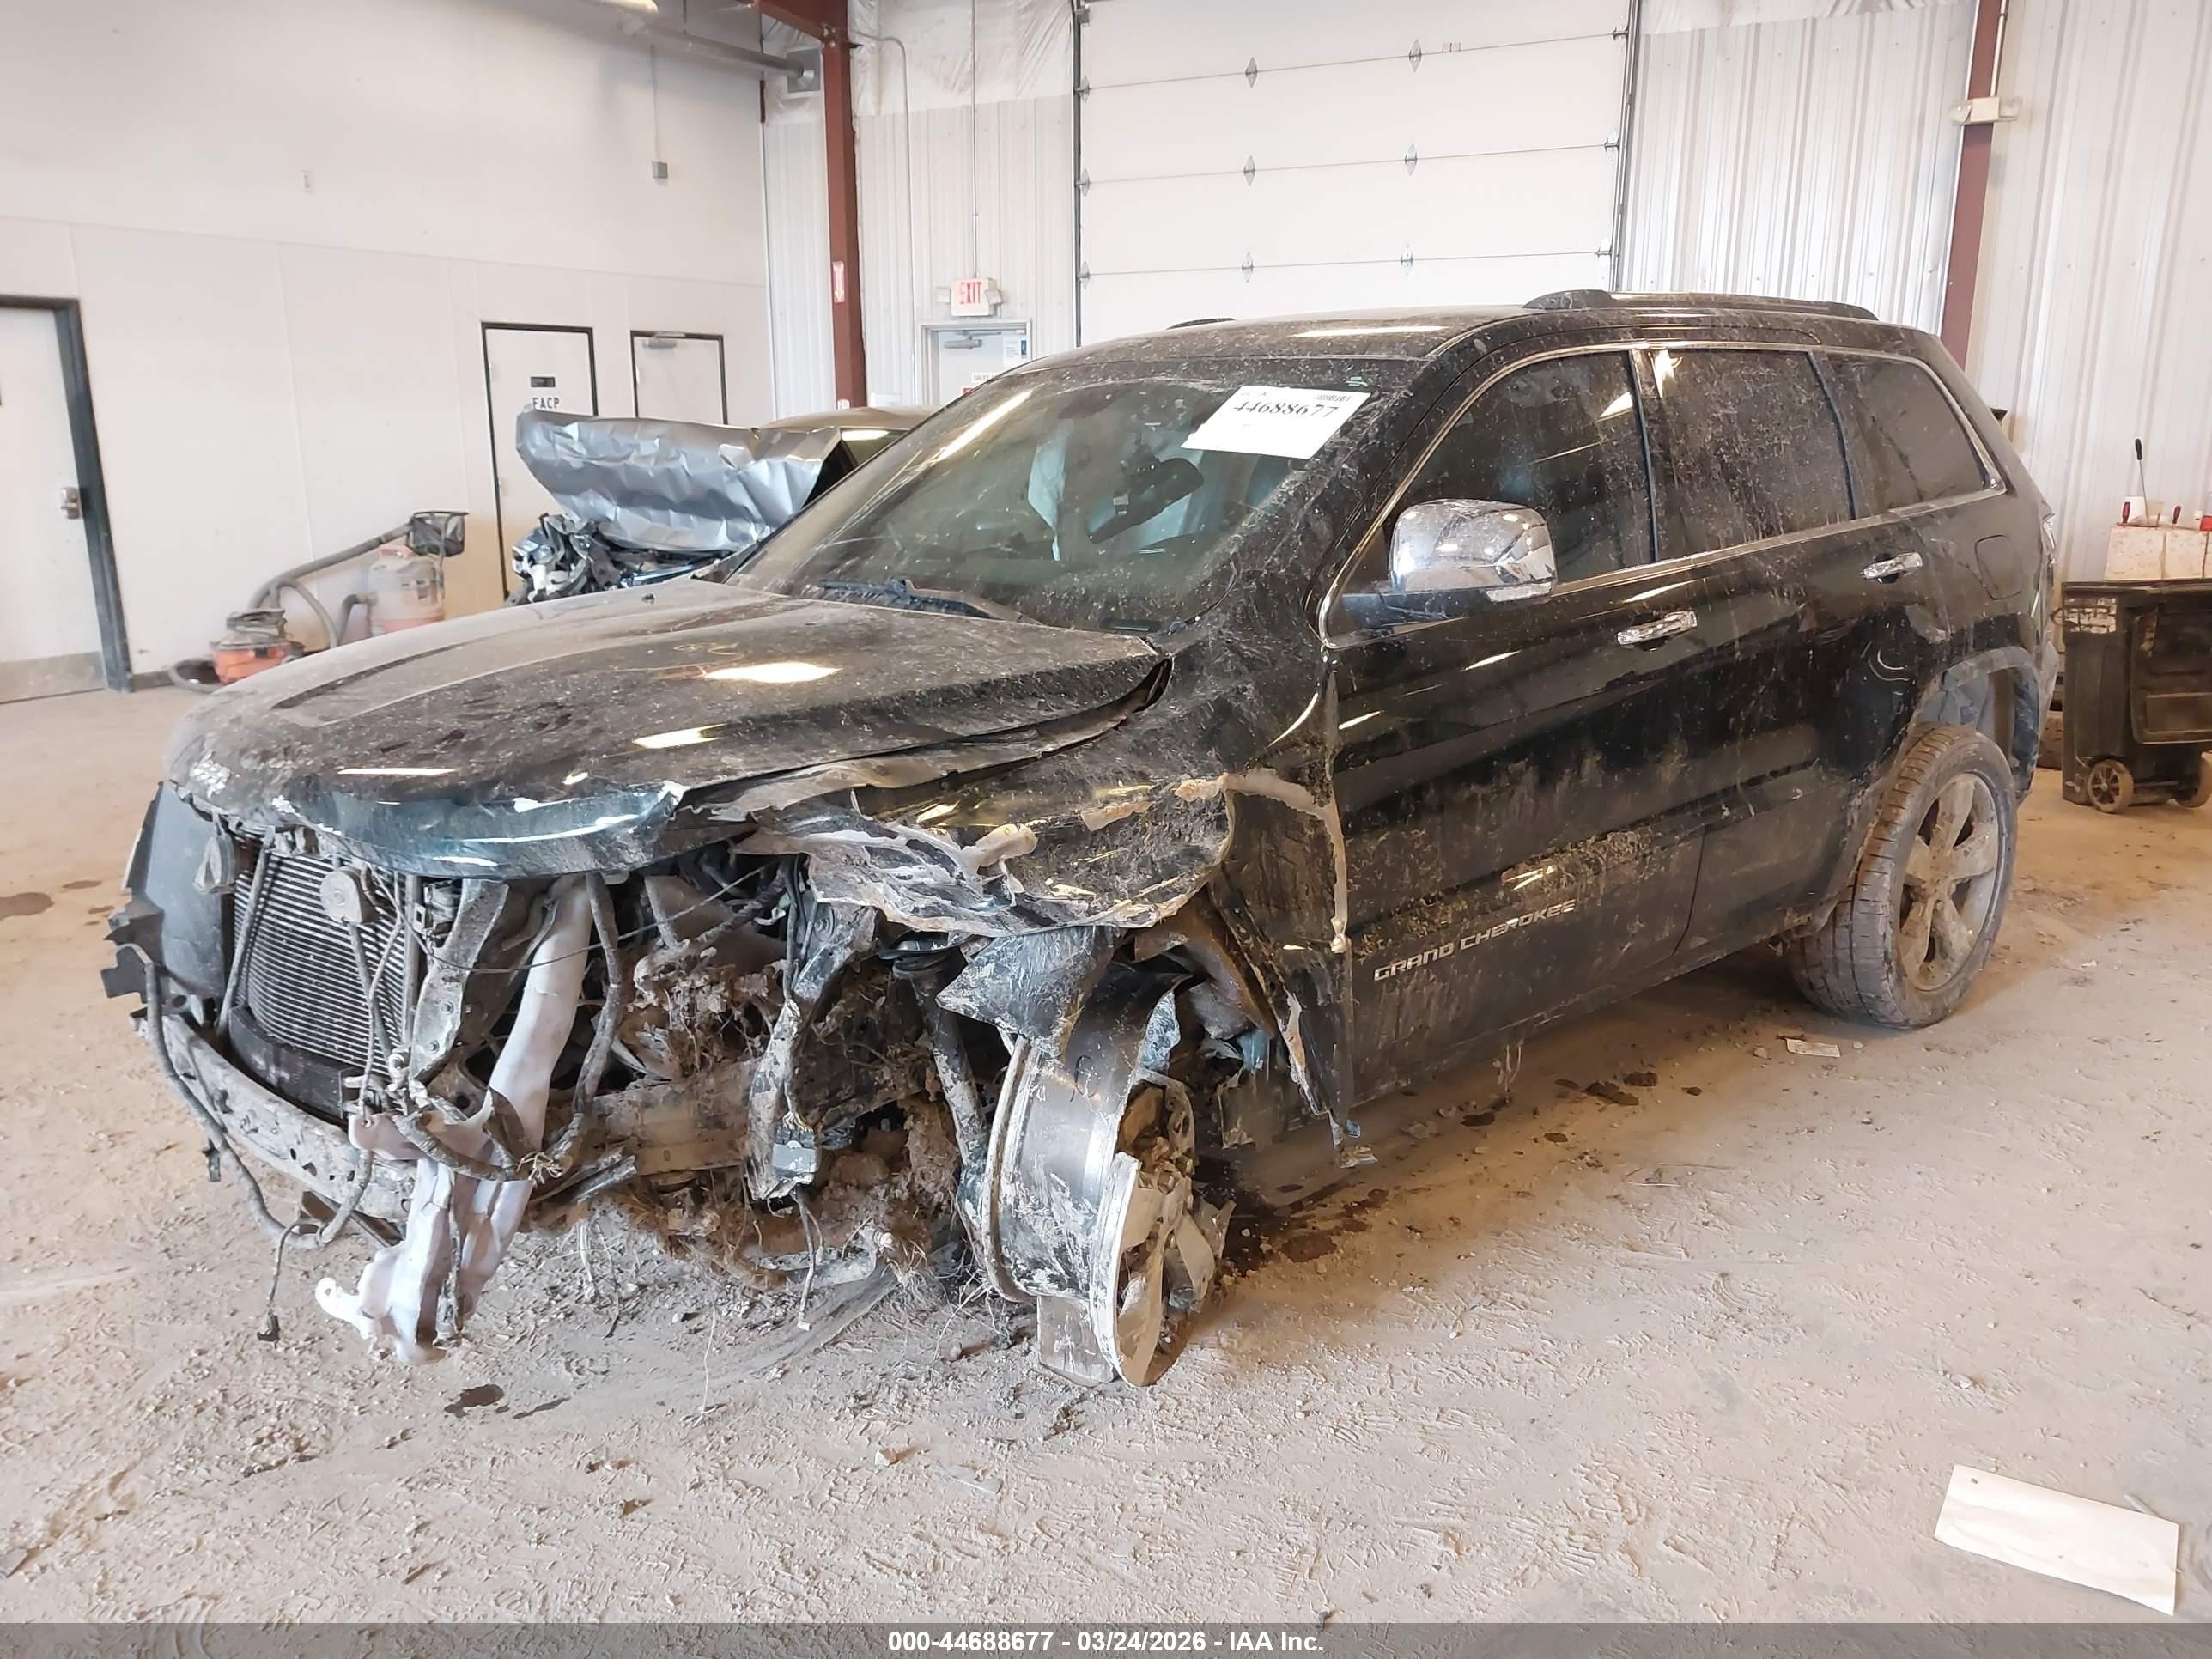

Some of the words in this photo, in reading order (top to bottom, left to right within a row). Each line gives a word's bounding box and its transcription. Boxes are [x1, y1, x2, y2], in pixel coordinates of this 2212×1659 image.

[959, 280, 982, 304] EXIT
[532, 397, 560, 409] FACP
[1232, 400, 1340, 418] 44688677
[1373, 943, 1455, 981] GRAND
[1460, 899, 1577, 951] CHEROKEE
